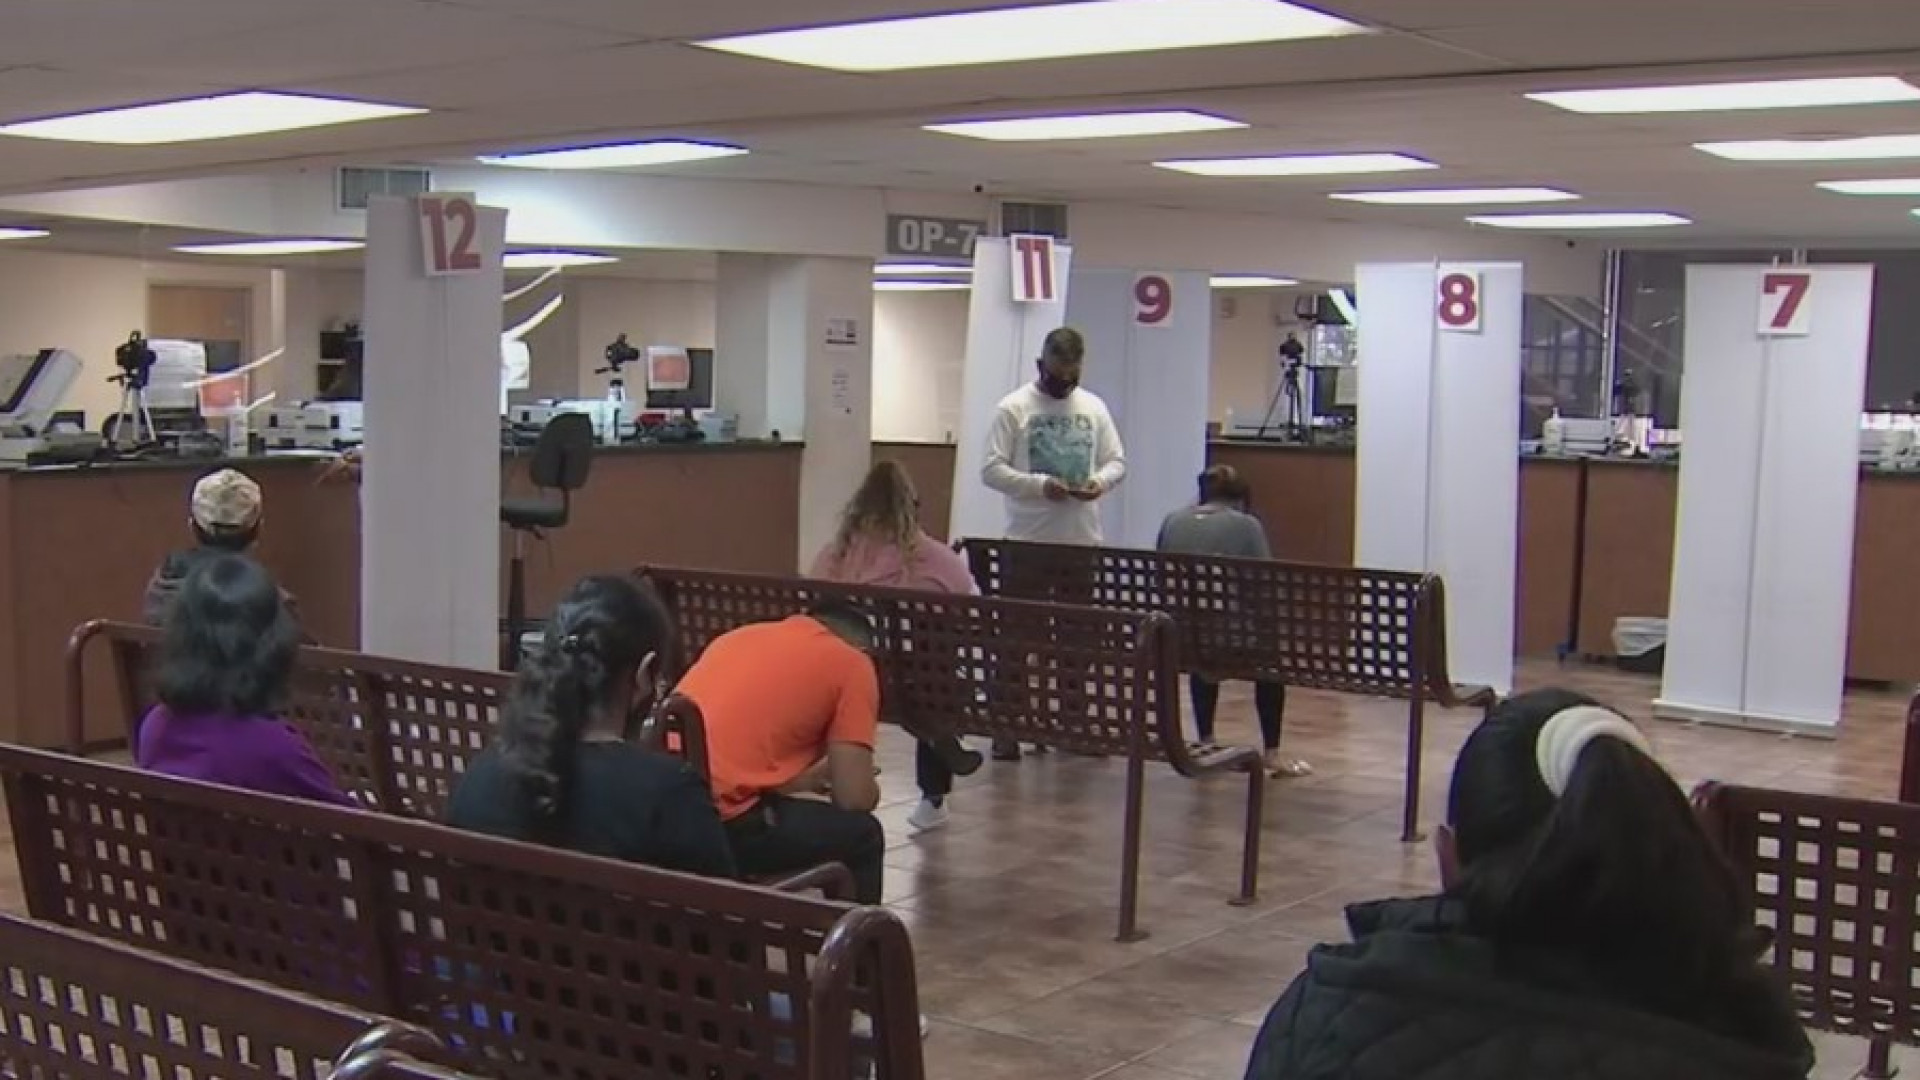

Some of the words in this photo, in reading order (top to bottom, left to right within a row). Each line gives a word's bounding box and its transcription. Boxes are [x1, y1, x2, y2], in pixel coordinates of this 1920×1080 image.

[421, 198, 482, 271] 12
[898, 219, 978, 255] OP-7
[1016, 238, 1052, 299] 11
[1135, 276, 1171, 323] 9
[1439, 273, 1477, 325] 8
[1763, 273, 1811, 328] 7
